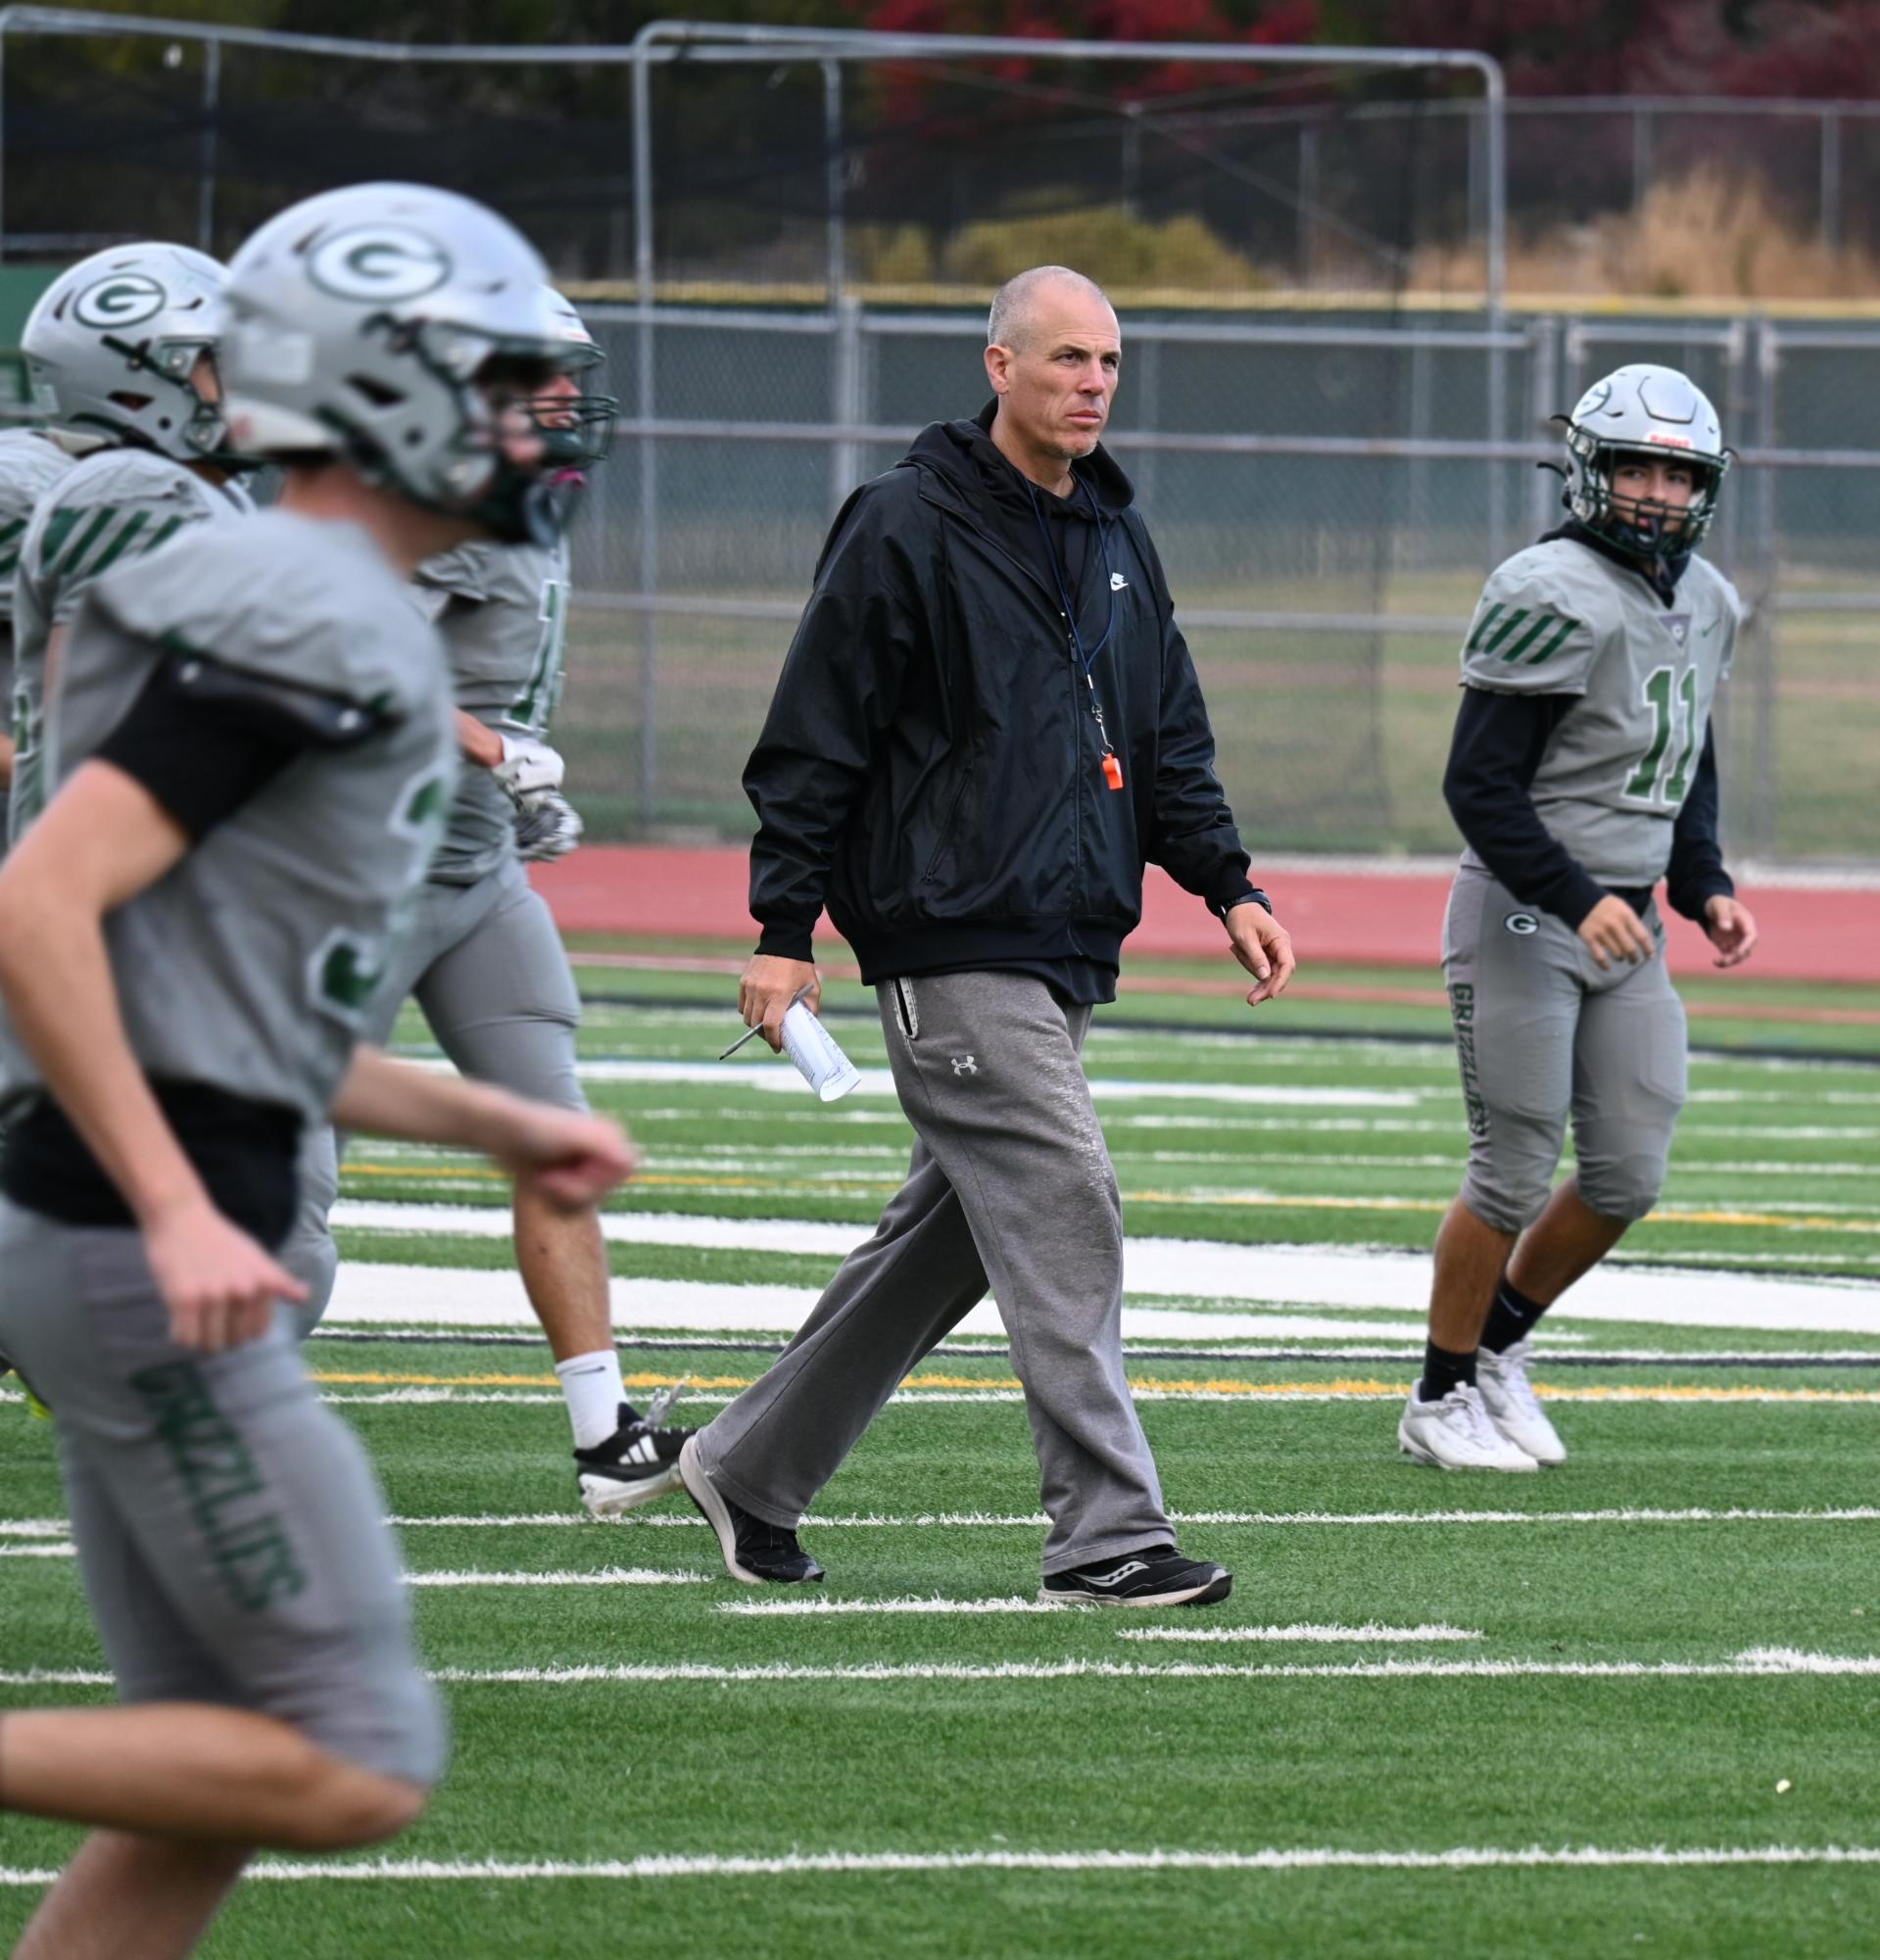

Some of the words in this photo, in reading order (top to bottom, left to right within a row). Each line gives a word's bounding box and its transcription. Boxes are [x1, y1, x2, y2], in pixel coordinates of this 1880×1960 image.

[306, 223, 453, 303] G
[73, 274, 166, 329] G
[1619, 663, 1698, 806] 11
[1504, 911, 1540, 935] G
